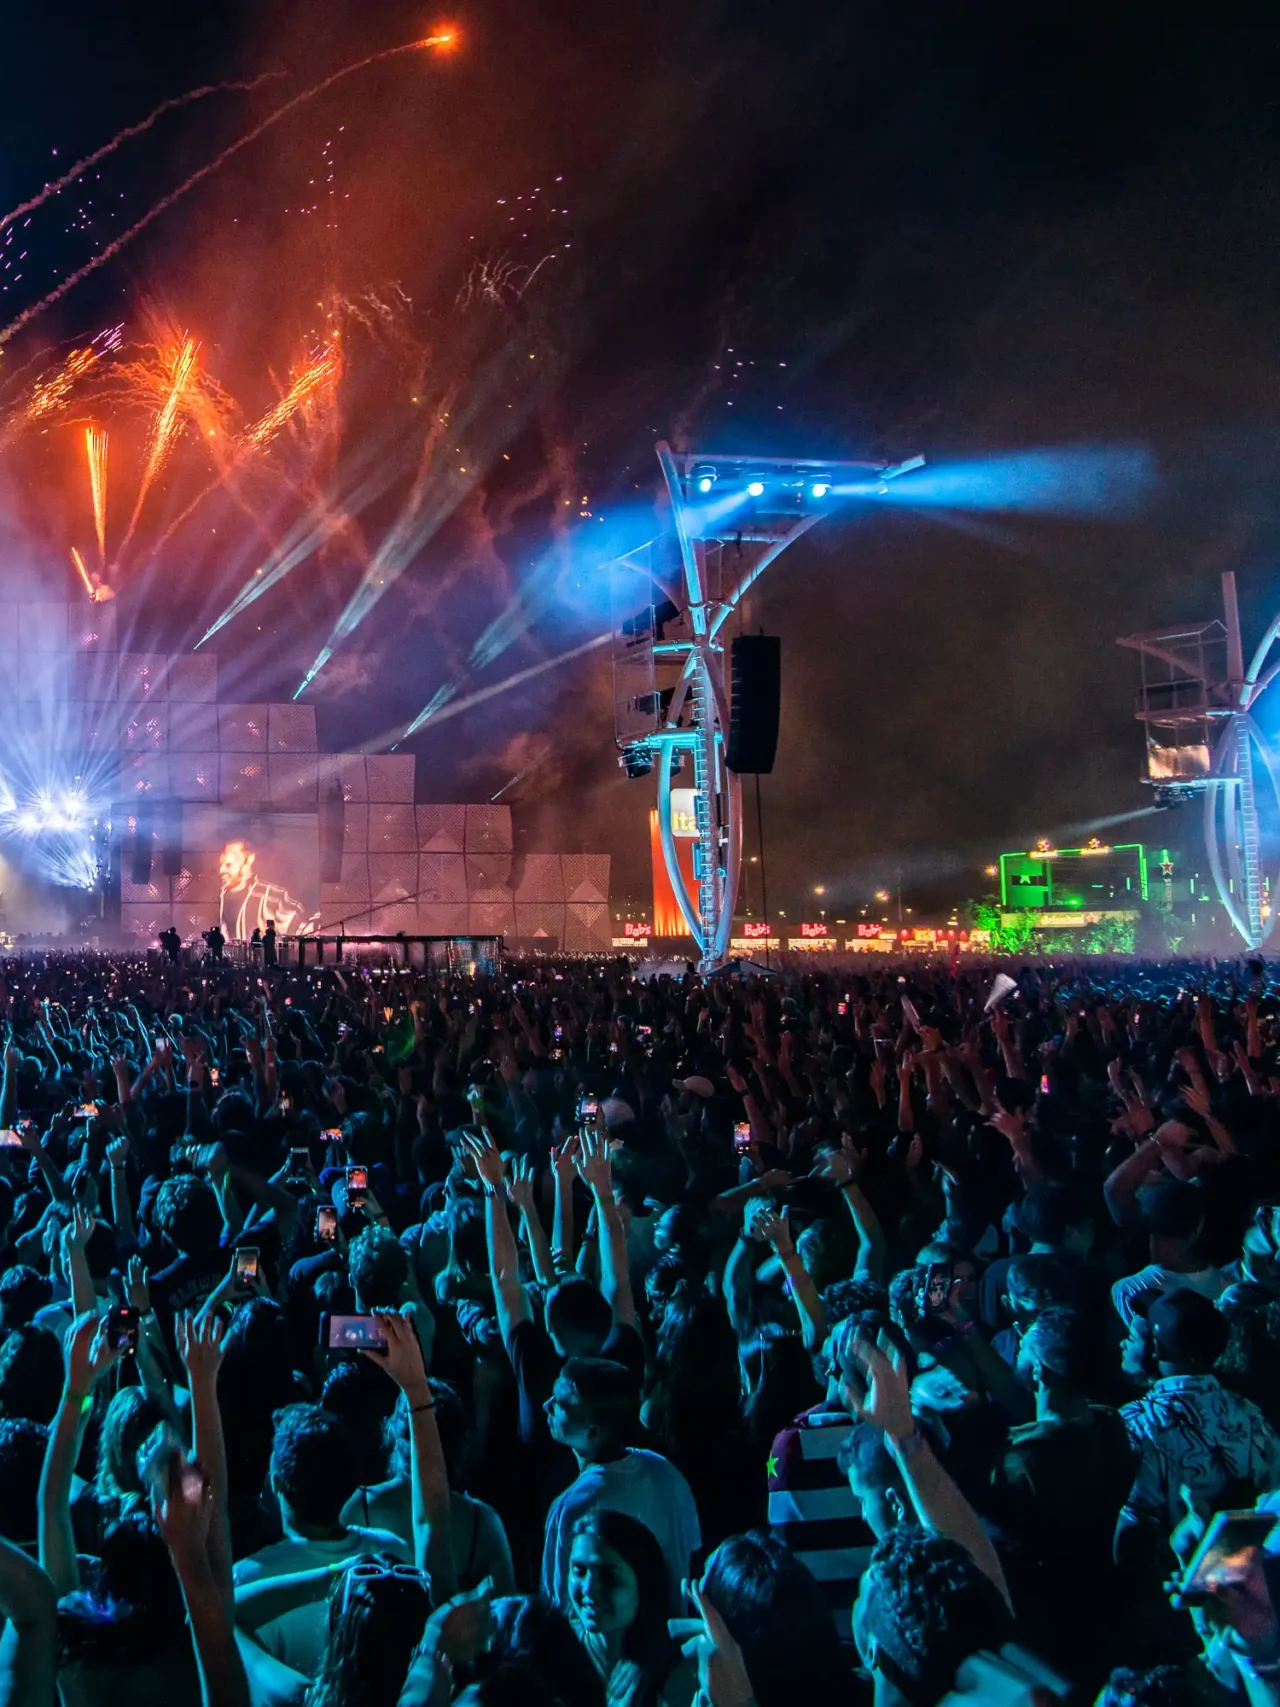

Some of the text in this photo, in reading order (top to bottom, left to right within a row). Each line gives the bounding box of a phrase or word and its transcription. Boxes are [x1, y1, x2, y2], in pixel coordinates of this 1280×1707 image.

[672, 812, 697, 831] Ita
[624, 922, 652, 937] Bob's
[743, 922, 771, 937] Bob's
[801, 922, 828, 937] Bob's
